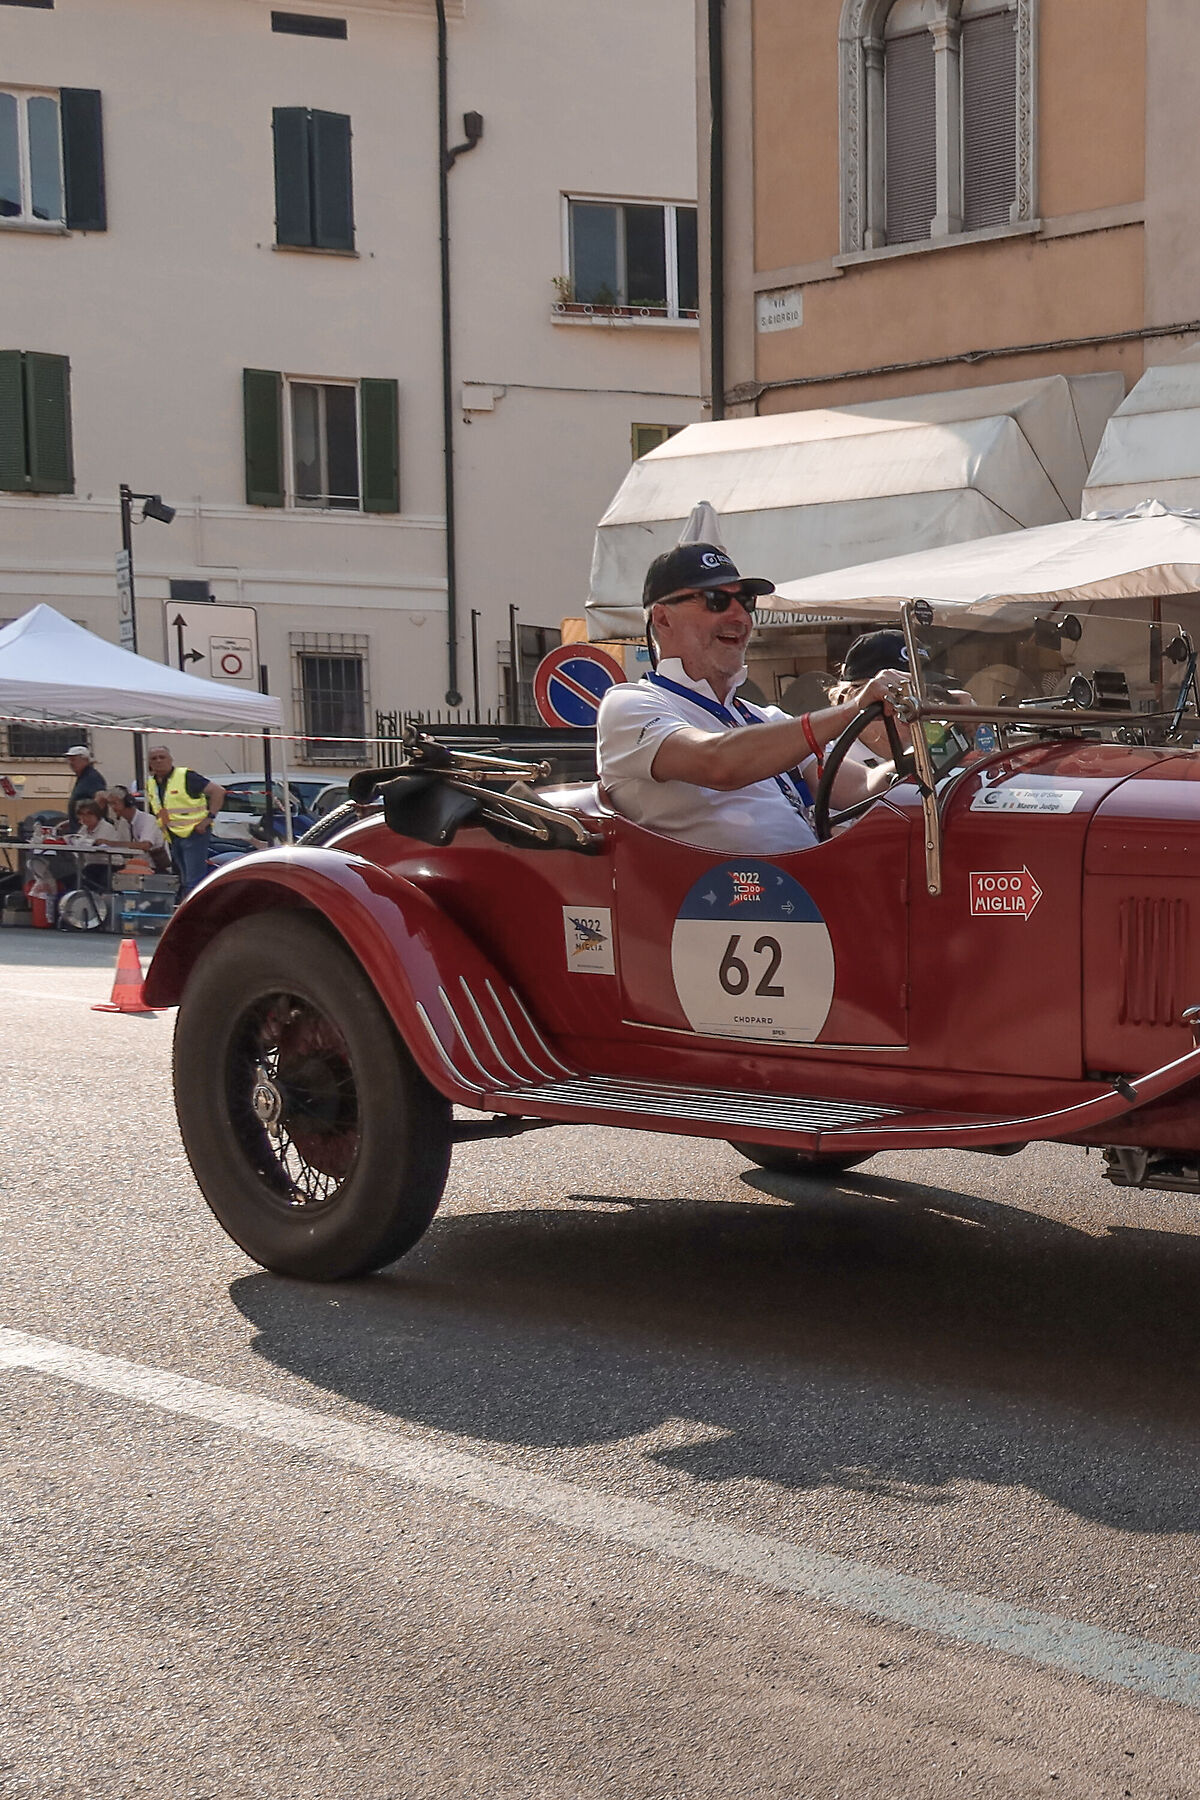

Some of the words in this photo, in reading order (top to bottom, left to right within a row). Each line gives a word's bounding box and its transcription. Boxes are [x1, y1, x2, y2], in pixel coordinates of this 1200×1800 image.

[773, 299, 786, 309] VIA
[733, 872, 760, 884] 2022
[977, 877, 1021, 891] 1000
[734, 885, 761, 893] 1000
[733, 894, 761, 902] MIGLIA
[975, 896, 1026, 911] MIGLIA
[574, 918, 602, 932] 2022
[719, 935, 785, 997] 62
[734, 1016, 773, 1024] CHOPARD
